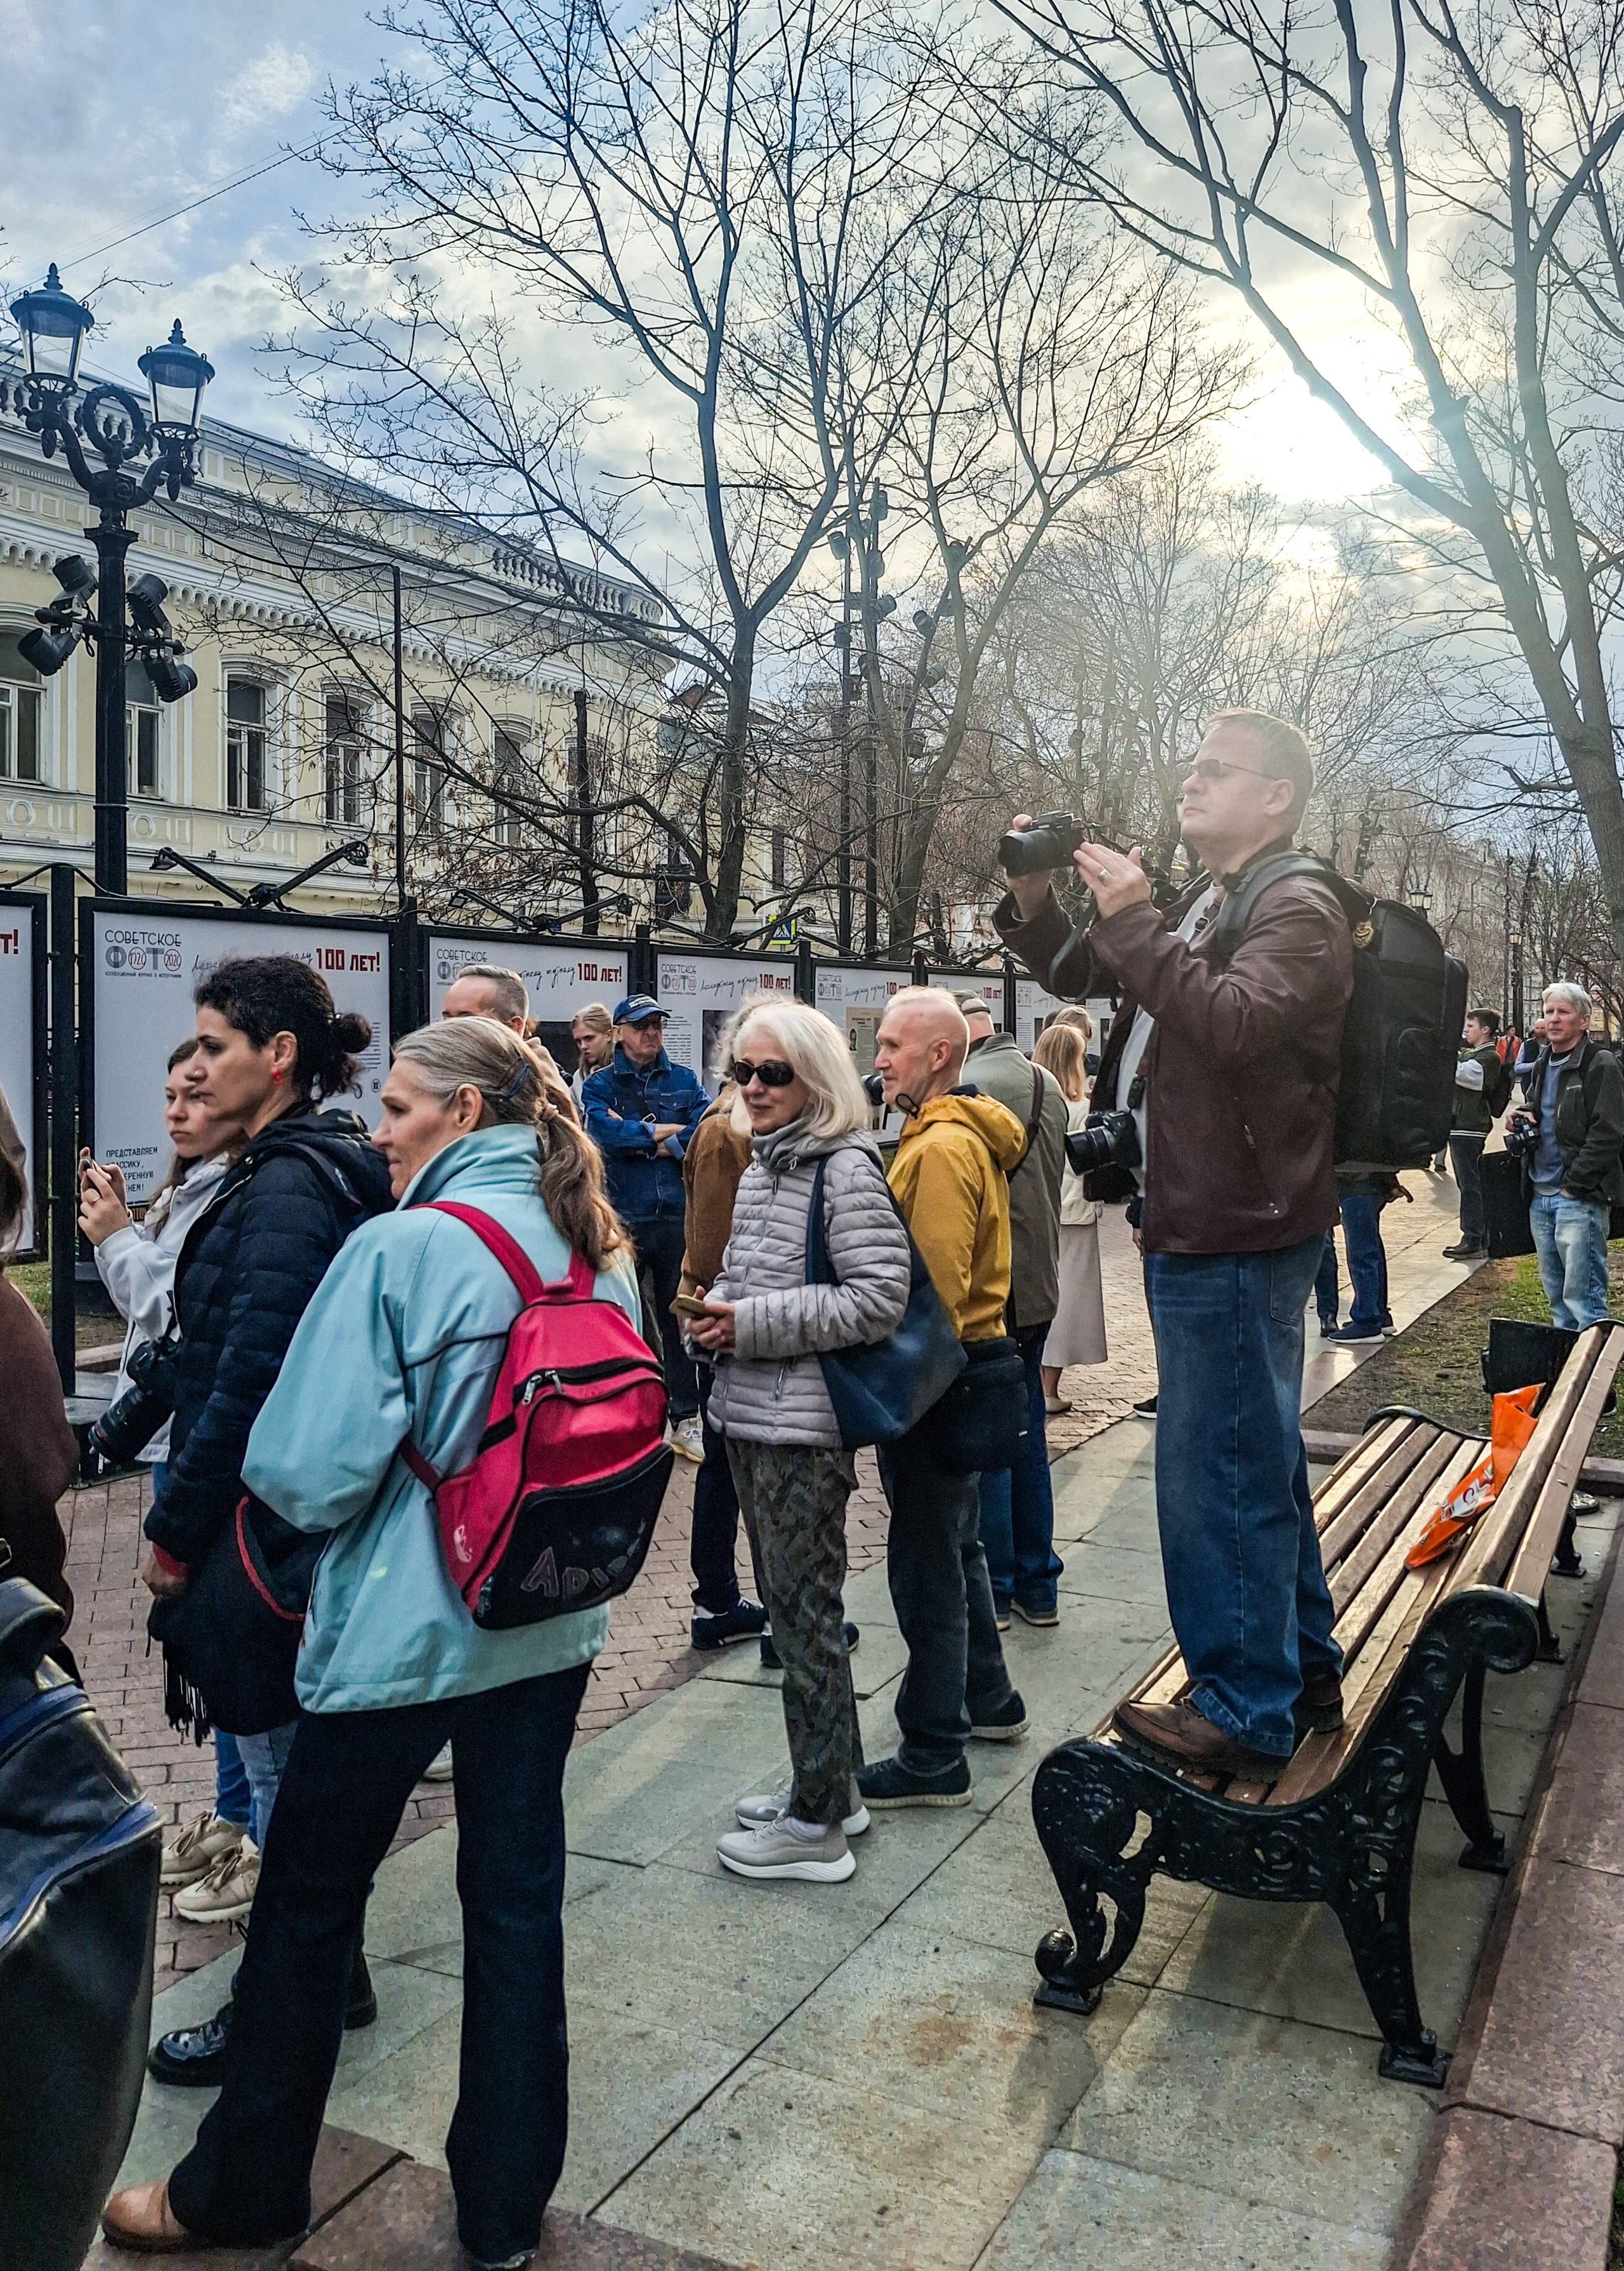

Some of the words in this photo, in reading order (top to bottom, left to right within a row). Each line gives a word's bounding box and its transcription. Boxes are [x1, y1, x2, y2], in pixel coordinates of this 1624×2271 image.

[105, 930, 181, 946] СОВЕТСКОЕ
[316, 948, 344, 970] 100
[350, 952, 380, 972] ЛЕТ!
[436, 949, 488, 962] СОВЕТСКОЕ
[578, 963, 598, 981] 100
[601, 965, 622, 983] ЛЕТ!
[759, 974, 773, 989] 100
[775, 976, 790, 990] ЛЕТ!
[886, 982, 897, 995] 100
[106, 1147, 157, 1158] ПРЕДСТАВЛЯЕМ
